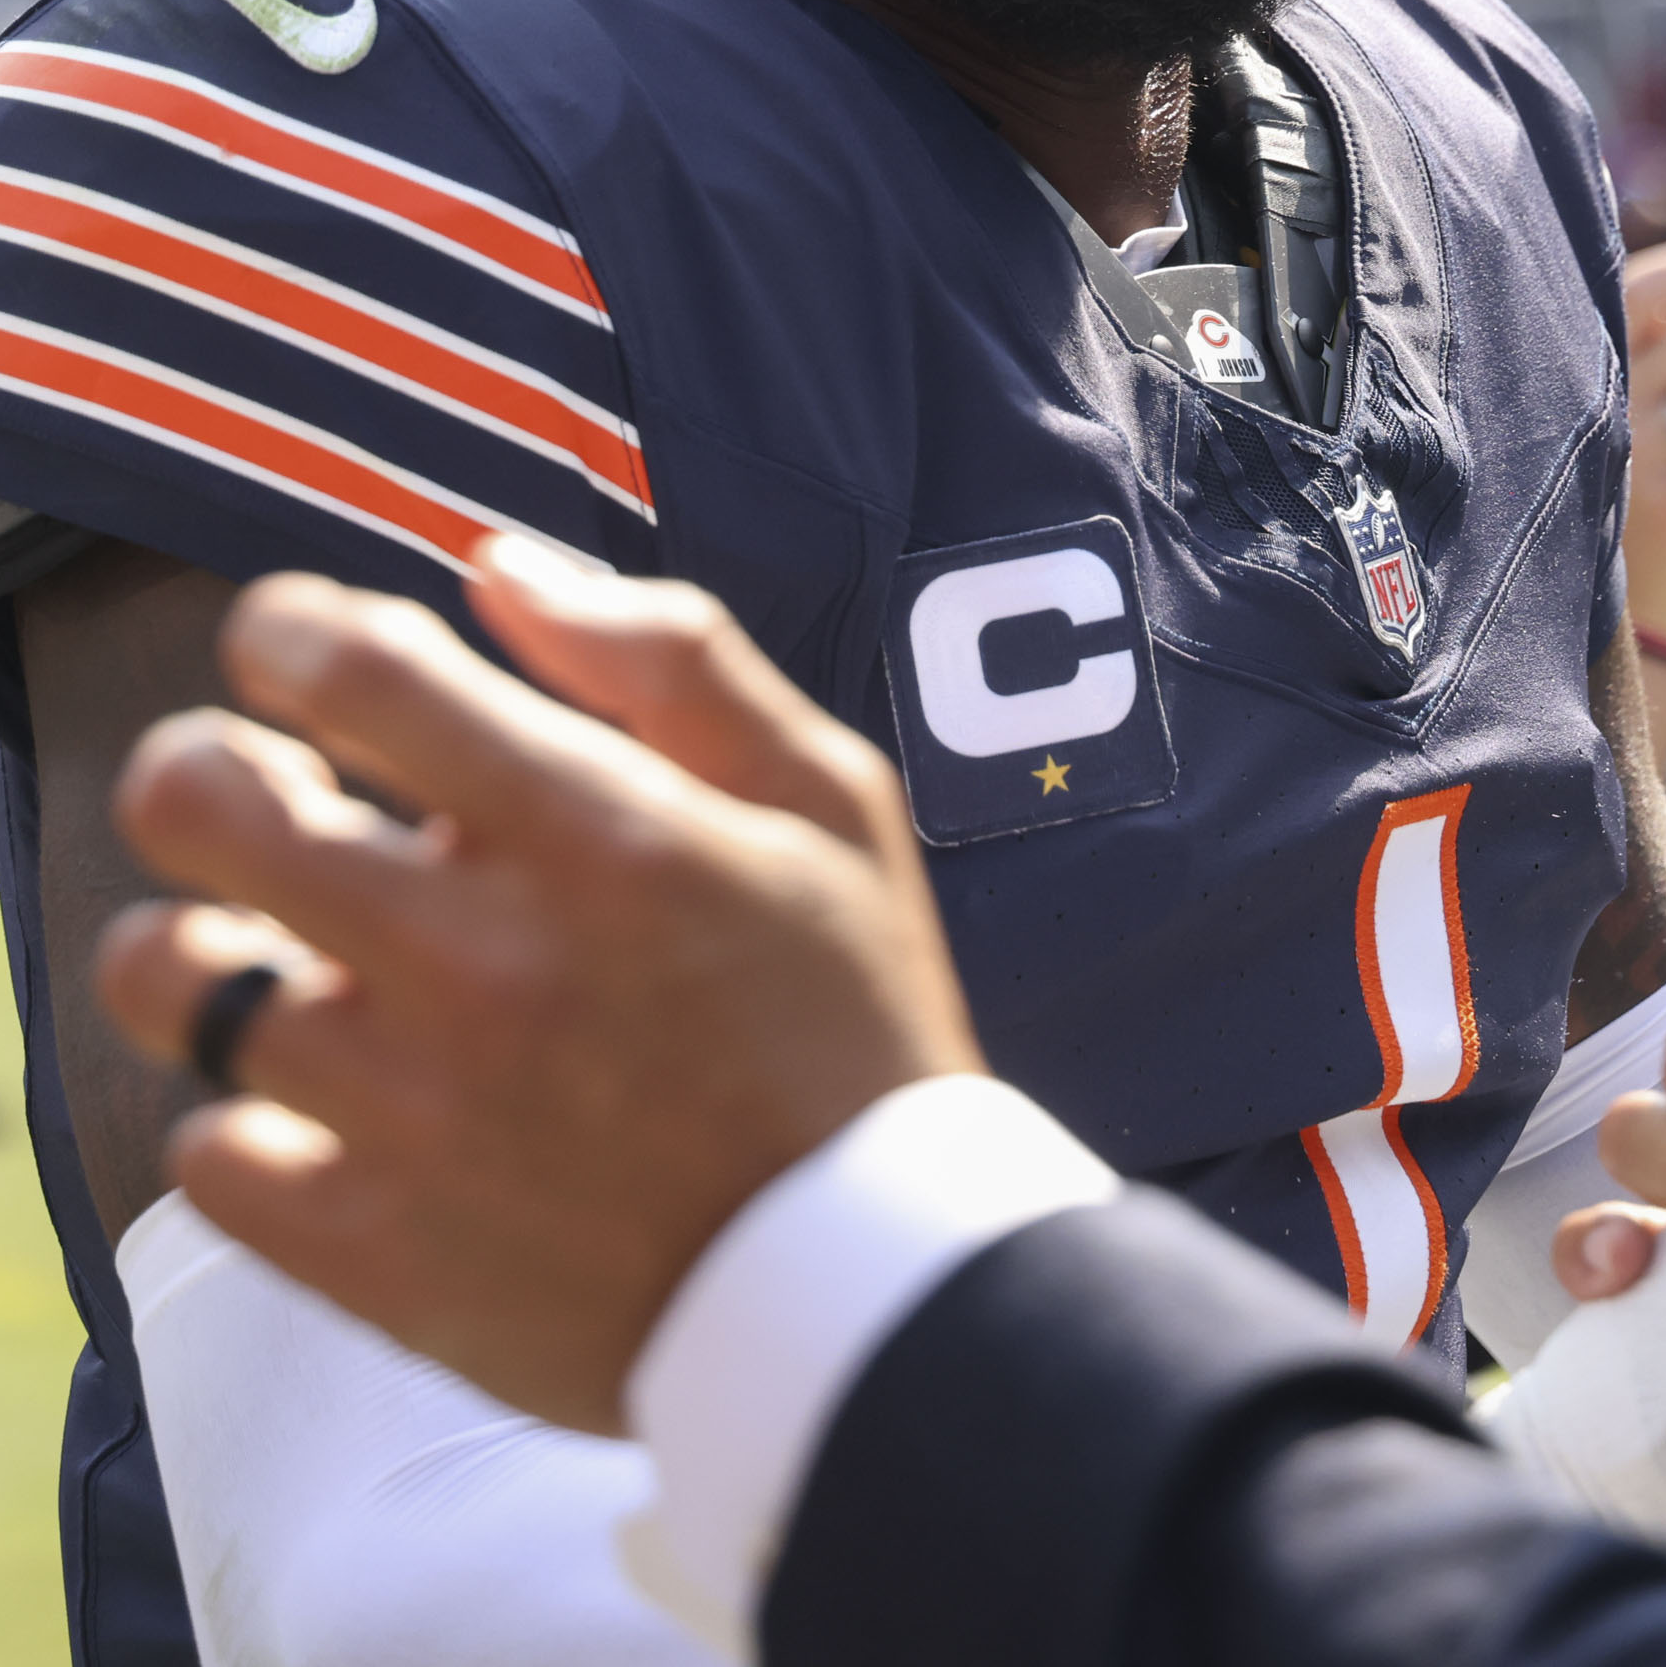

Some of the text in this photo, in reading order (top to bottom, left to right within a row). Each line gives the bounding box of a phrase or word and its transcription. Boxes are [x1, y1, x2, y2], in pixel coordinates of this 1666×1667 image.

[1217, 357, 1259, 377] JOHNSON
[1369, 556, 1417, 624] NFL
[910, 548, 1137, 758] C
